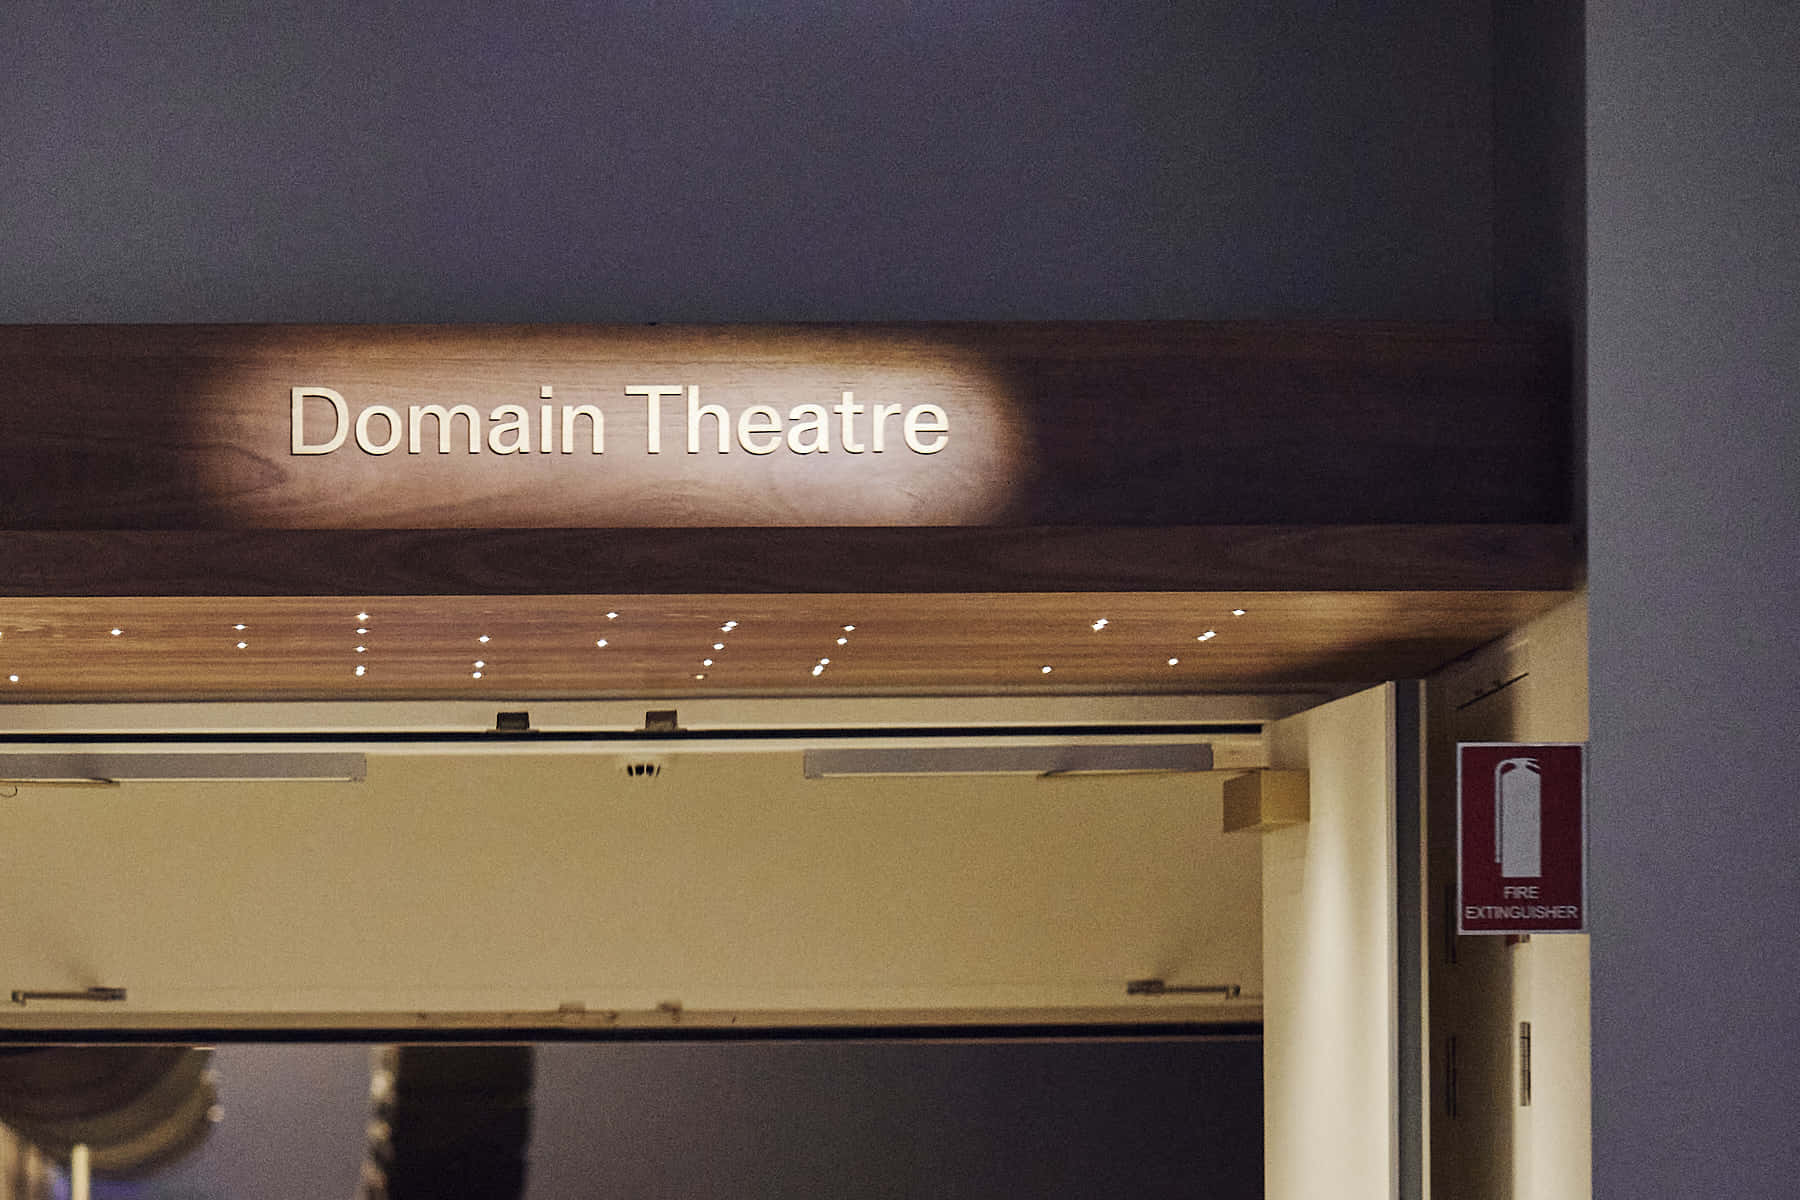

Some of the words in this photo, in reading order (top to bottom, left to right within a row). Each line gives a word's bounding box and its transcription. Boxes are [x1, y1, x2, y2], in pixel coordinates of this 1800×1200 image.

[290, 385, 604, 456] Domain
[624, 384, 950, 456] Theatre
[1504, 885, 1540, 899] FIRE
[1465, 905, 1579, 919] EXTINGUISHER
